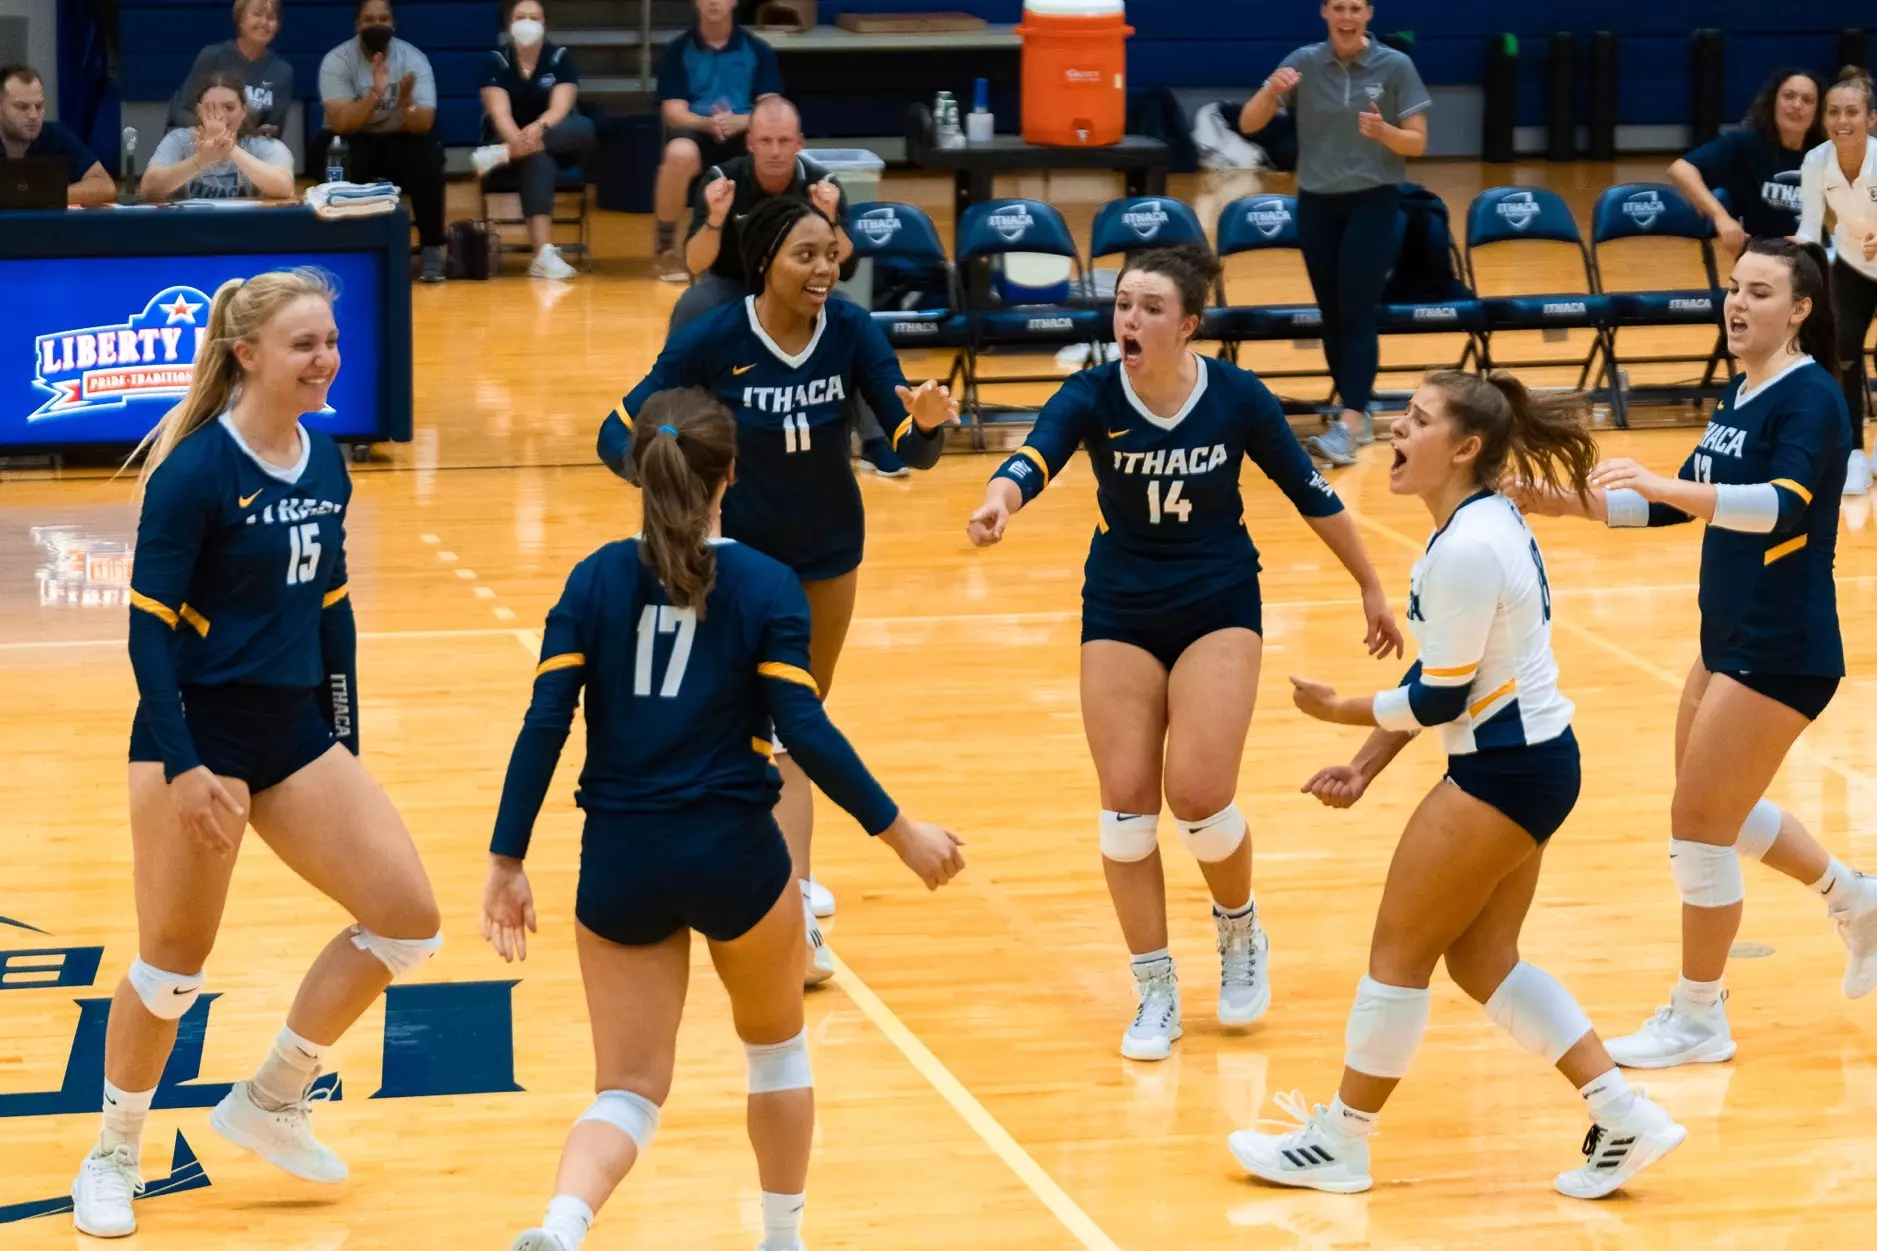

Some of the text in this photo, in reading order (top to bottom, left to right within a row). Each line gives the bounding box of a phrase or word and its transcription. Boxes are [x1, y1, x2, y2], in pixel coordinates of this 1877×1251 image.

[1761, 181, 1802, 202] ITHA
[1496, 202, 1541, 214] ITHACA
[1622, 201, 1666, 213] ITHACA
[988, 214, 1034, 228] ITHACA
[1121, 212, 1168, 225] ITHACA
[1246, 209, 1292, 223] ITHACA
[857, 218, 903, 230] ITHACA
[1543, 302, 1587, 314] ITHACA
[1668, 298, 1712, 309] ITHACA
[1413, 307, 1458, 318] ITHACA
[893, 321, 938, 333] ITHACA
[1028, 317, 1074, 330] ITHACA
[42, 327, 183, 375] LIBERTY
[743, 374, 846, 413] ITHACA
[783, 412, 811, 453] 11
[1698, 420, 1748, 459] HACA
[1114, 443, 1228, 476] ITHACA
[1147, 480, 1192, 524] 14
[287, 522, 322, 585] 15
[634, 604, 697, 698] 17
[330, 674, 351, 738] ITHACA
